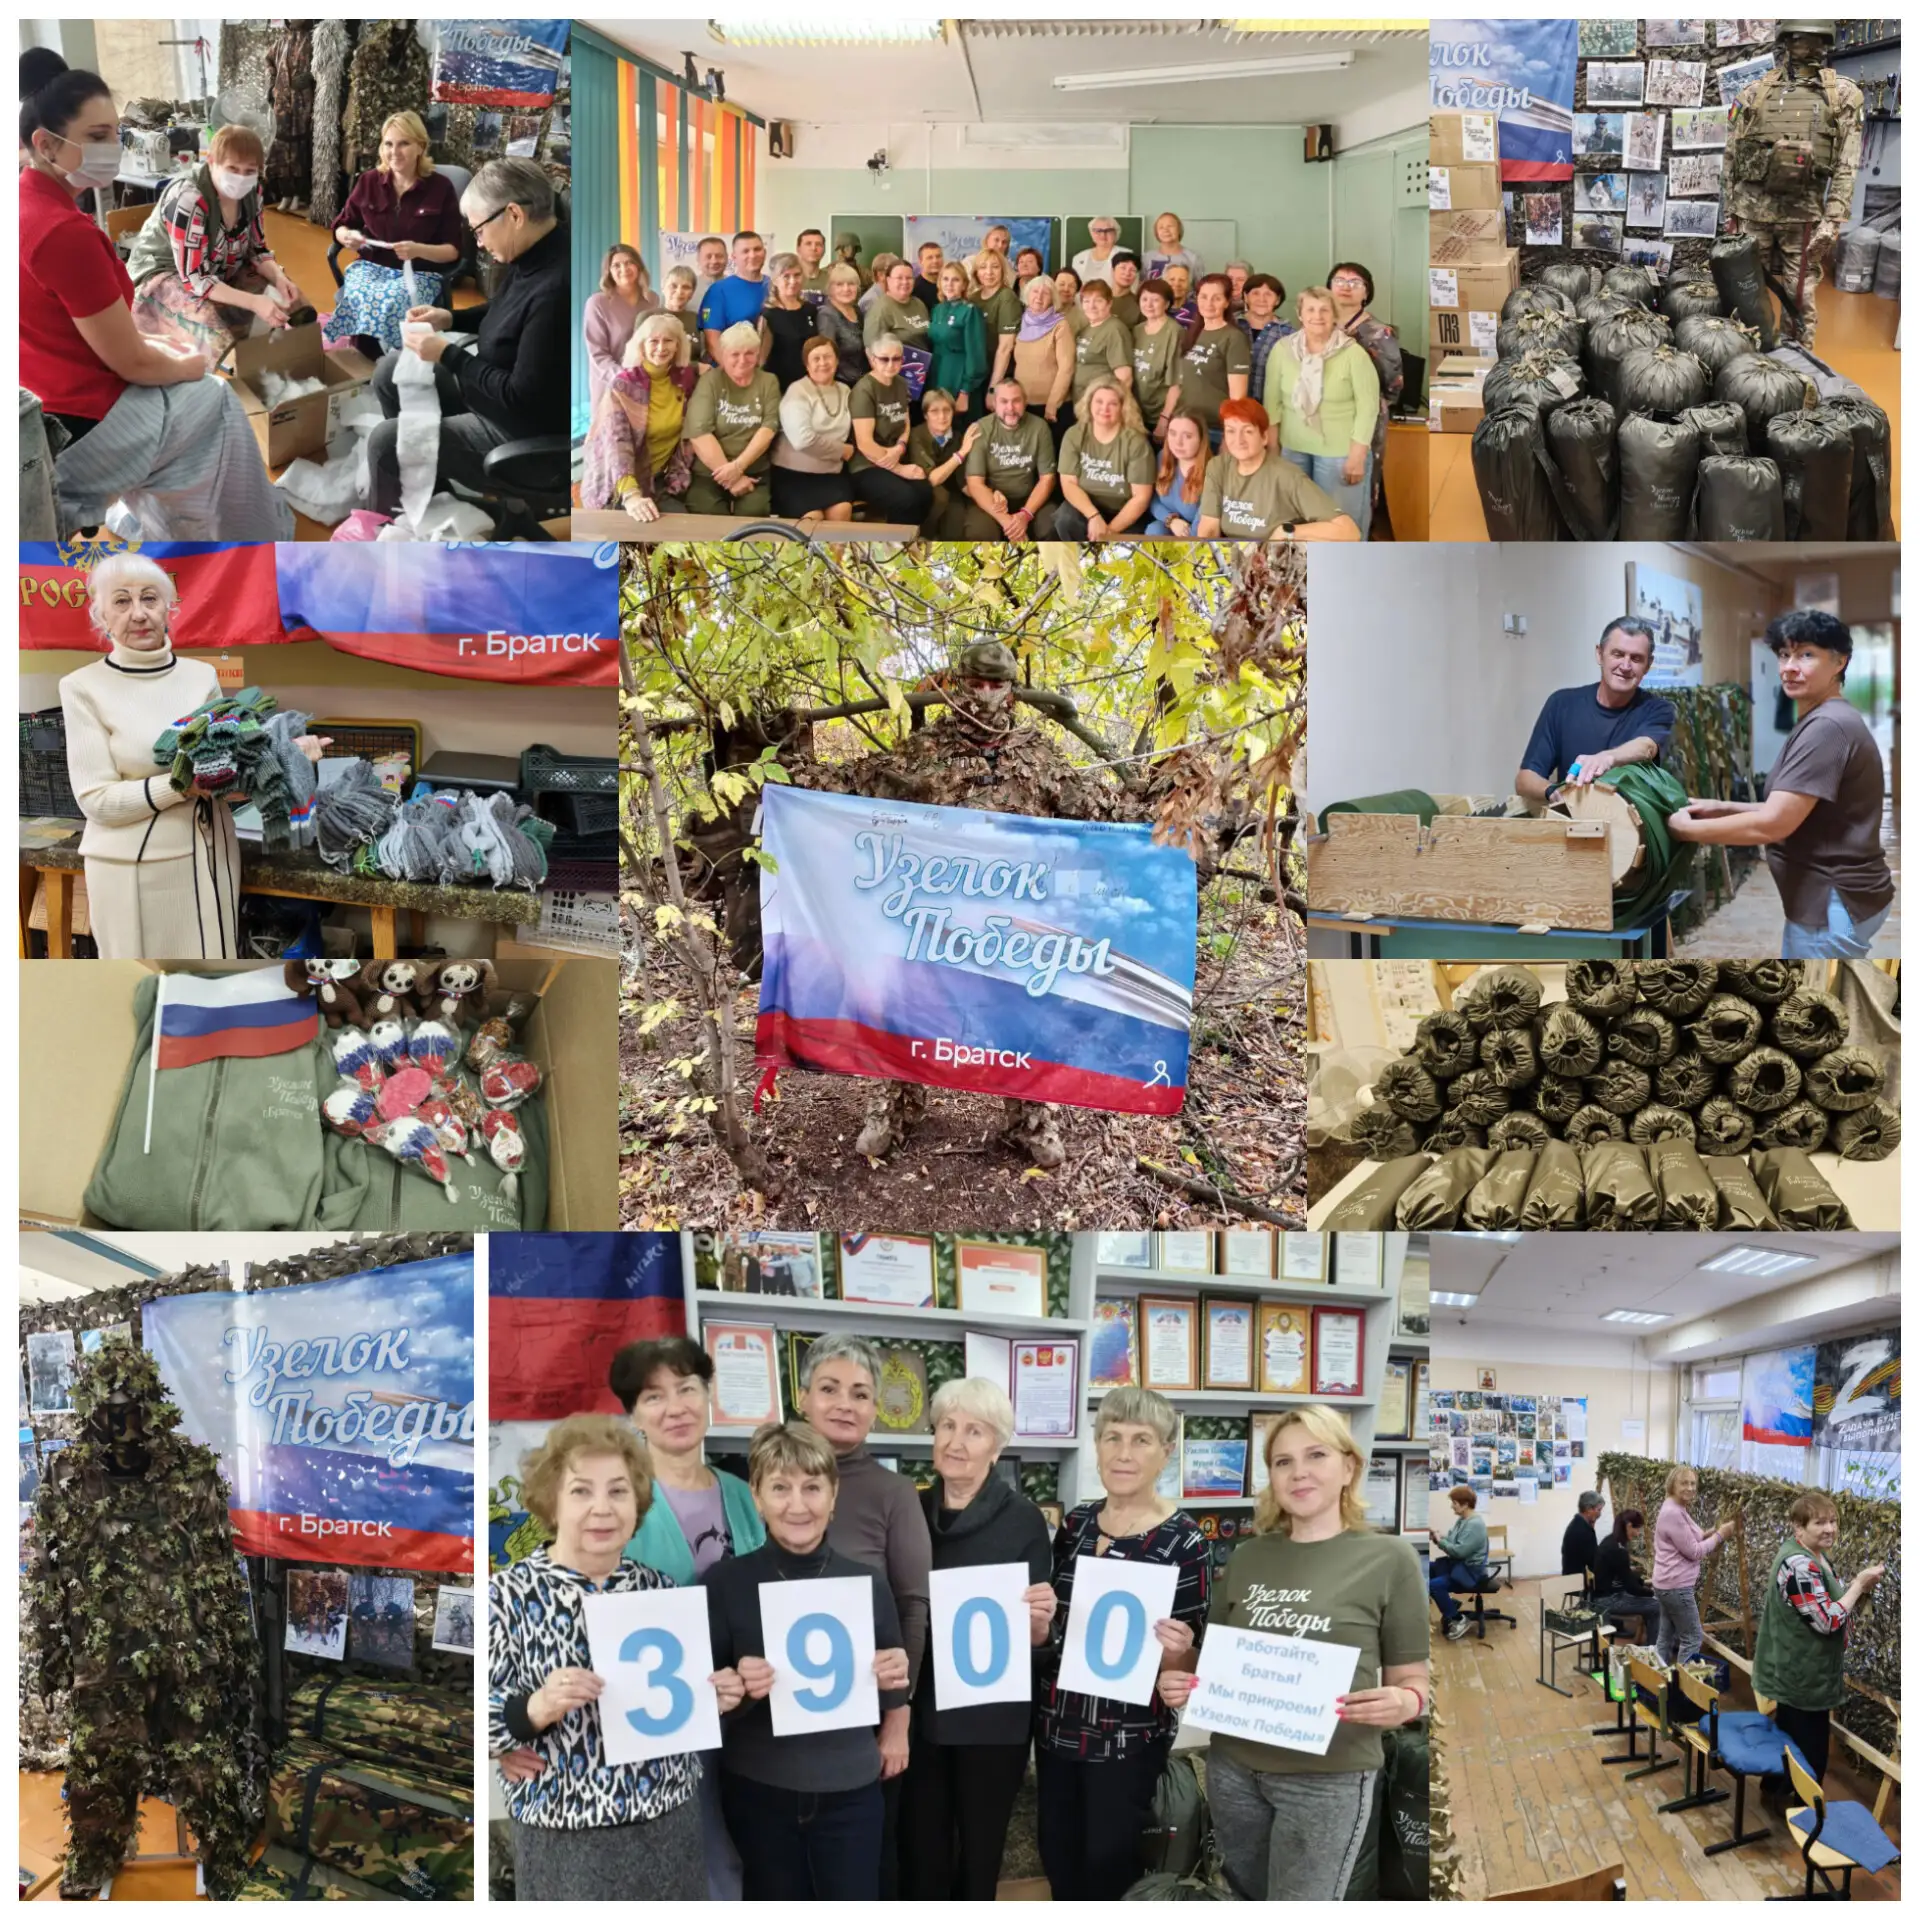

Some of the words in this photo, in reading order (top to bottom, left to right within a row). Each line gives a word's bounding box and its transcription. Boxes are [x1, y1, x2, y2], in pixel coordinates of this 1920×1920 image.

[449, 28, 533, 61] Победы
[1429, 42, 1491, 67] лок
[1438, 313, 1460, 344] ГАЗ
[458, 637, 477, 656] г.
[486, 629, 601, 661] Братск
[853, 830, 1048, 918] Узелок
[899, 905, 1116, 997] Победы
[910, 1040, 927, 1060] г.
[934, 1037, 1033, 1071] Братск
[223, 1325, 411, 1408] Узелок
[267, 1388, 475, 1469] Победы
[279, 1516, 295, 1533] г.
[300, 1512, 393, 1540] Братск
[1243, 1584, 1312, 1610] Узелок
[1249, 1604, 1332, 1638] Победы
[618, 1627, 694, 1737] 3
[786, 1613, 854, 1712] 9
[951, 1596, 1010, 1688] 0
[1084, 1590, 1146, 1681] 0
[1236, 1636, 1320, 1665] Работайте,
[1241, 1662, 1302, 1686] Братья!
[1208, 1682, 1234, 1699] Мы
[1237, 1691, 1325, 1718] прикроем!
[1190, 1705, 1251, 1728] «Узелок
[1253, 1718, 1325, 1744] Победы»
